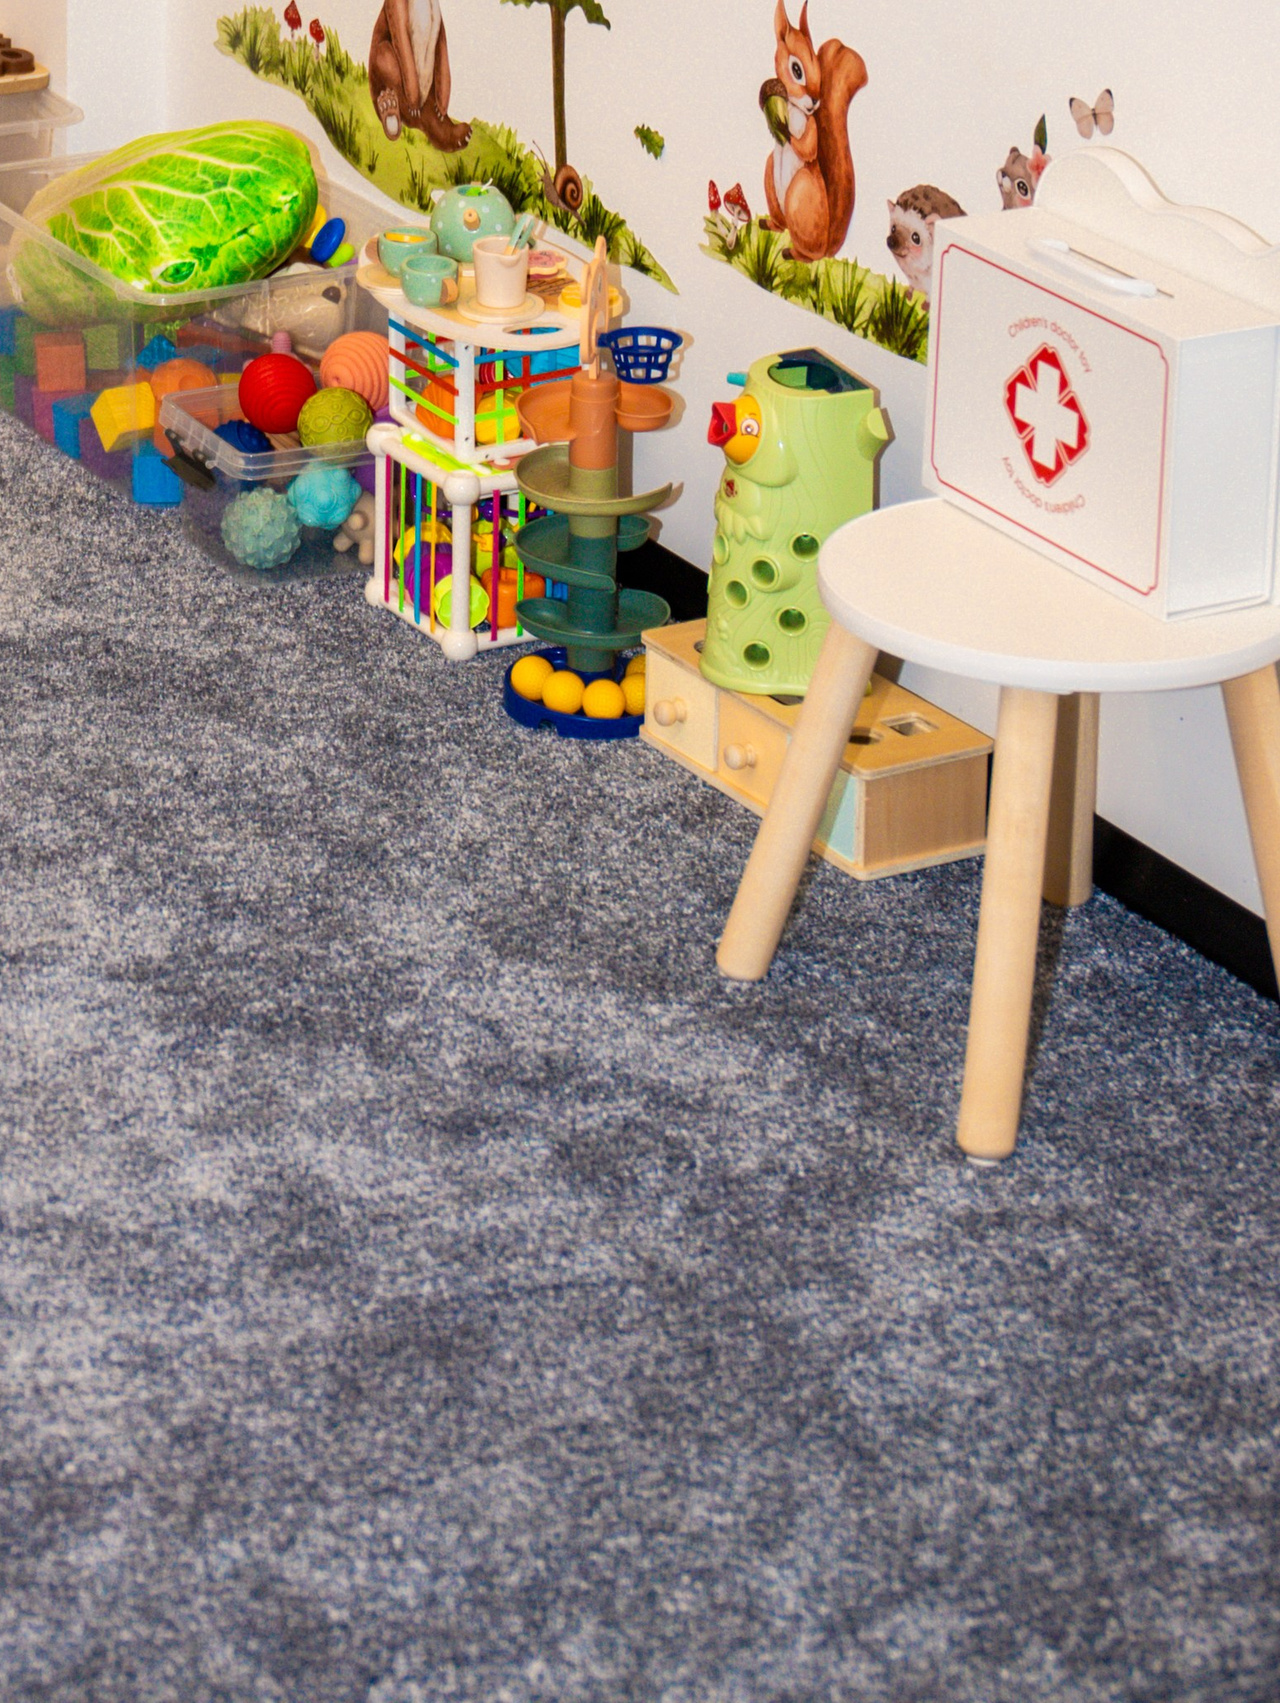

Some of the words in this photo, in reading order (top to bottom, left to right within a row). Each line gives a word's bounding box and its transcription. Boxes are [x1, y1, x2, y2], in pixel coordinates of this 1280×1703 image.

[1008, 317, 1048, 338] Children's
[1050, 322, 1079, 352] doctor
[1079, 351, 1094, 373] toy
[1015, 477, 1042, 507] doctor
